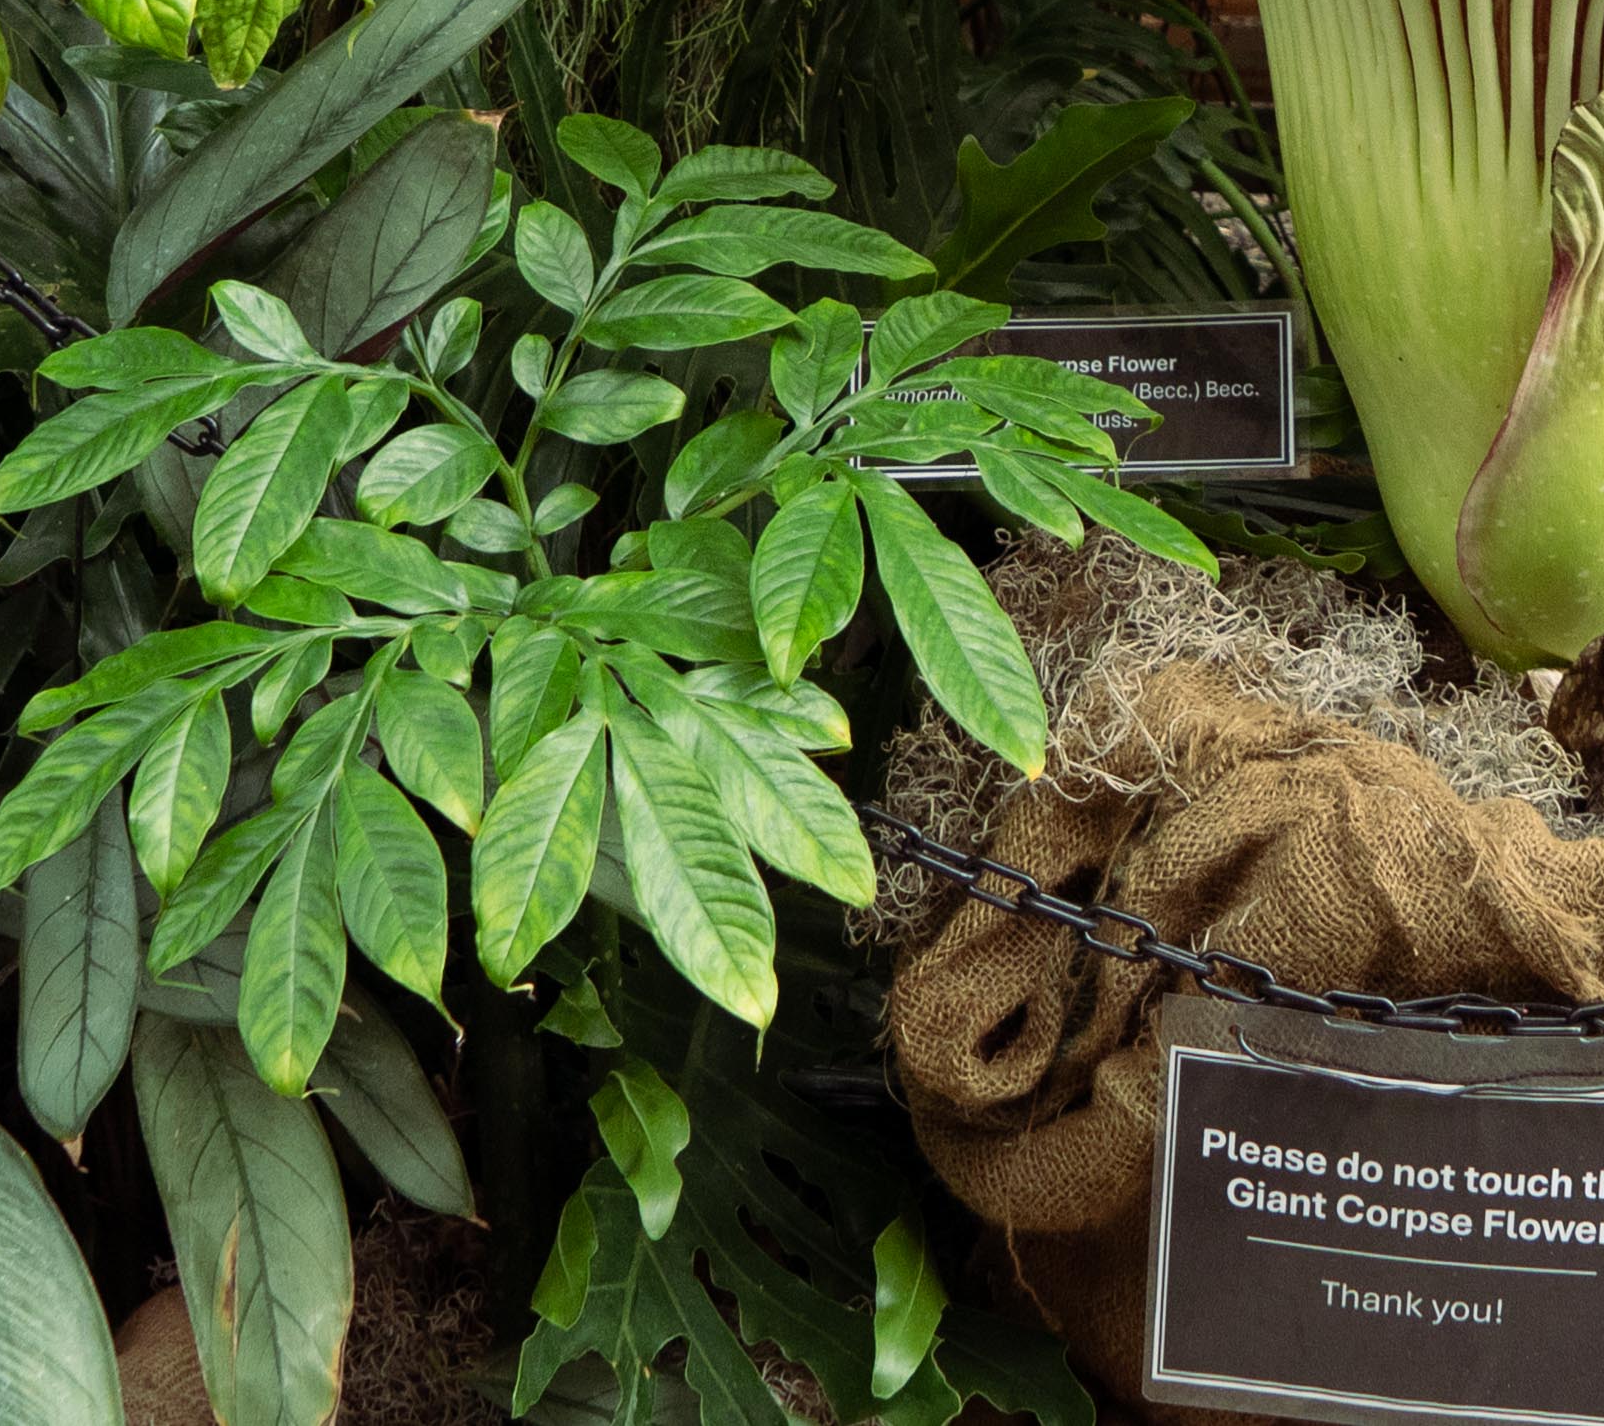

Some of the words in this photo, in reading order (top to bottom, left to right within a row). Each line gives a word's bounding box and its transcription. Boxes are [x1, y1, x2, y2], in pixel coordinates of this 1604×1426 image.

[1108, 355, 1177, 373] Flower
[1133, 381, 1200, 402] (Becc.)
[1205, 380, 1260, 398] Becc.
[1201, 1128, 1327, 1176] Please
[1336, 1152, 1384, 1183] do
[1393, 1163, 1455, 1191] not
[1464, 1168, 1573, 1200] touch
[1226, 1177, 1327, 1220] Giant
[1336, 1194, 1472, 1238] Corpse
[1321, 1280, 1423, 1318] Thank
[1432, 1298, 1504, 1325] you!
